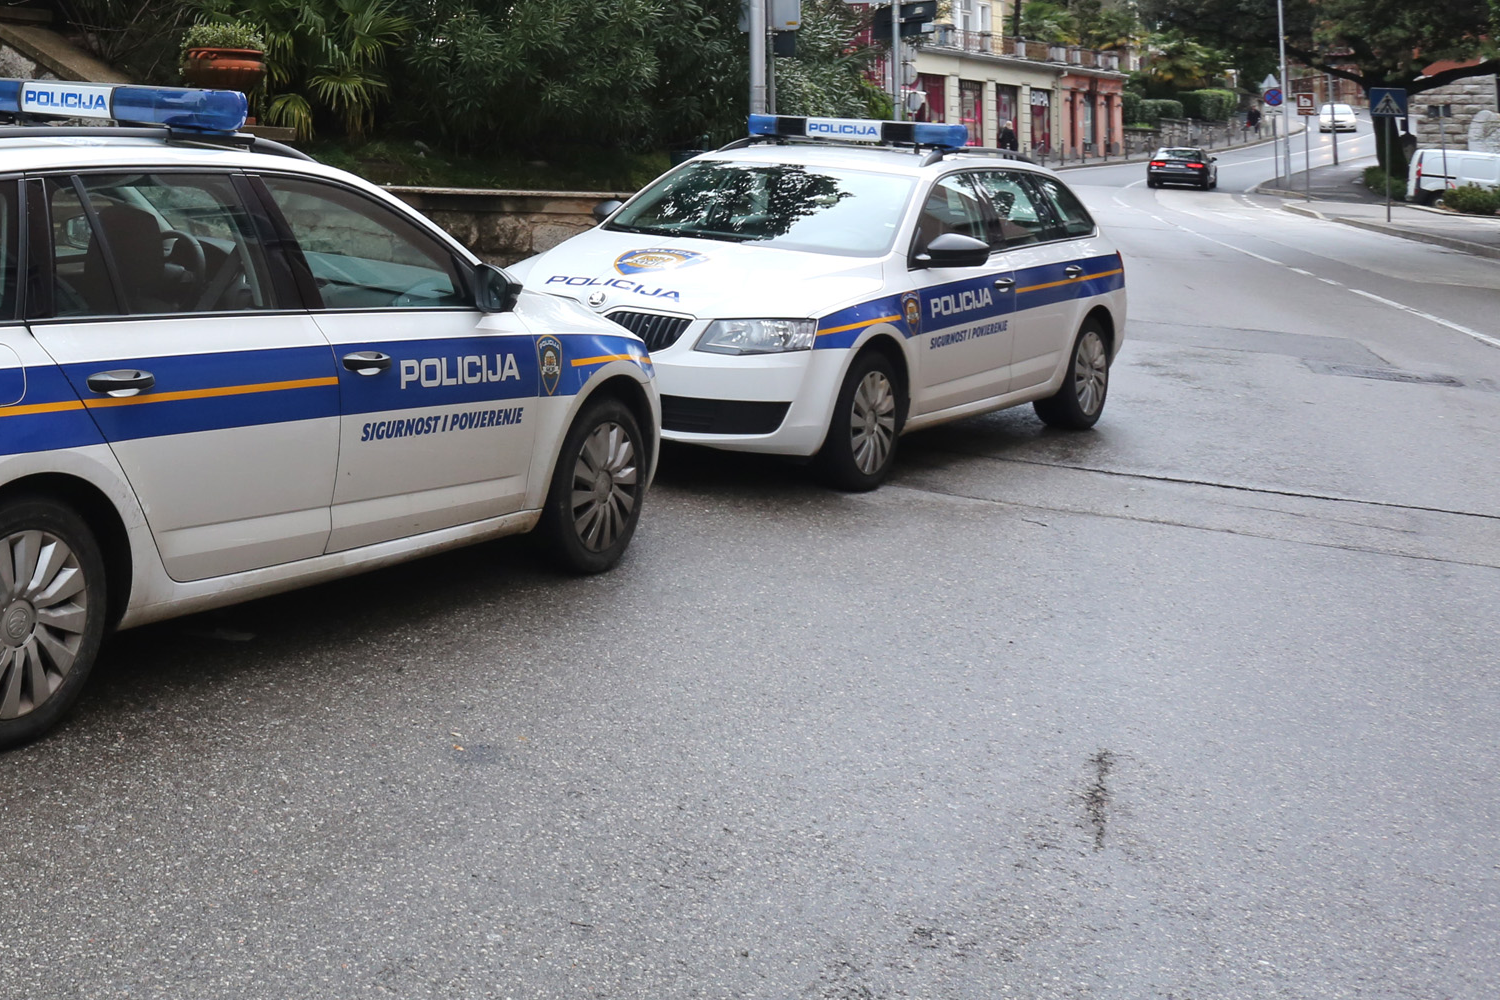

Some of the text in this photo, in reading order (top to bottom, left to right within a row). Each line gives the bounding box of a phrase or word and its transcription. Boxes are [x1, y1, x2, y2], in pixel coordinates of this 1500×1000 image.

[25, 90, 107, 110] POLICIJA
[808, 123, 878, 136] POLICIJA
[545, 275, 680, 302] POLICIJA
[930, 287, 993, 319] POLICIJA
[930, 332, 967, 350] SIGURNOST
[400, 353, 520, 389] POLICIJA
[361, 407, 524, 442] SIGURNOST I POVJERENJE
